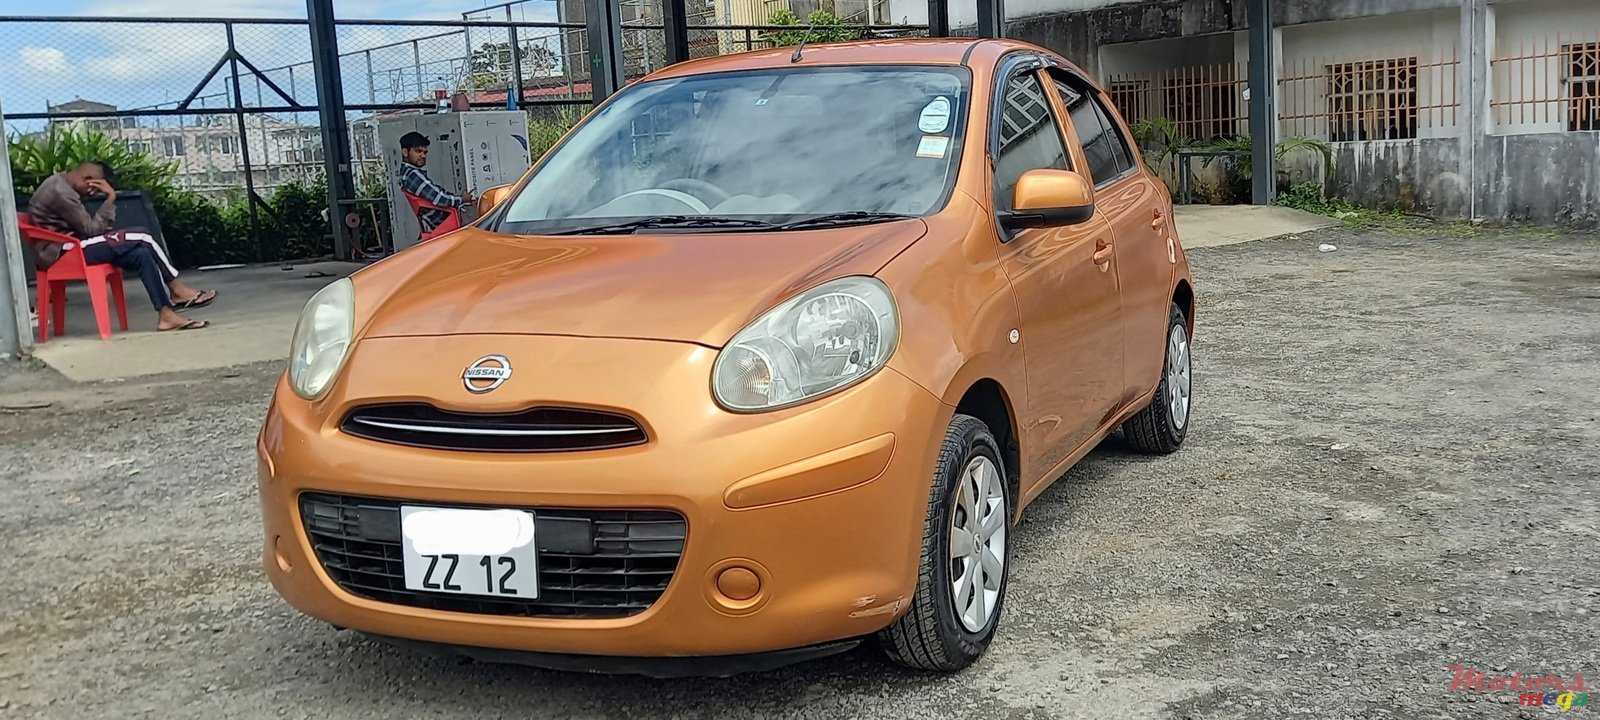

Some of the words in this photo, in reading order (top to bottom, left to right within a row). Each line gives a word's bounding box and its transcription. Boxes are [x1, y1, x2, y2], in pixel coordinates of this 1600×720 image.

[465, 368, 505, 377] NISSAN
[420, 553, 462, 591] ZZ
[479, 555, 518, 595] 12
